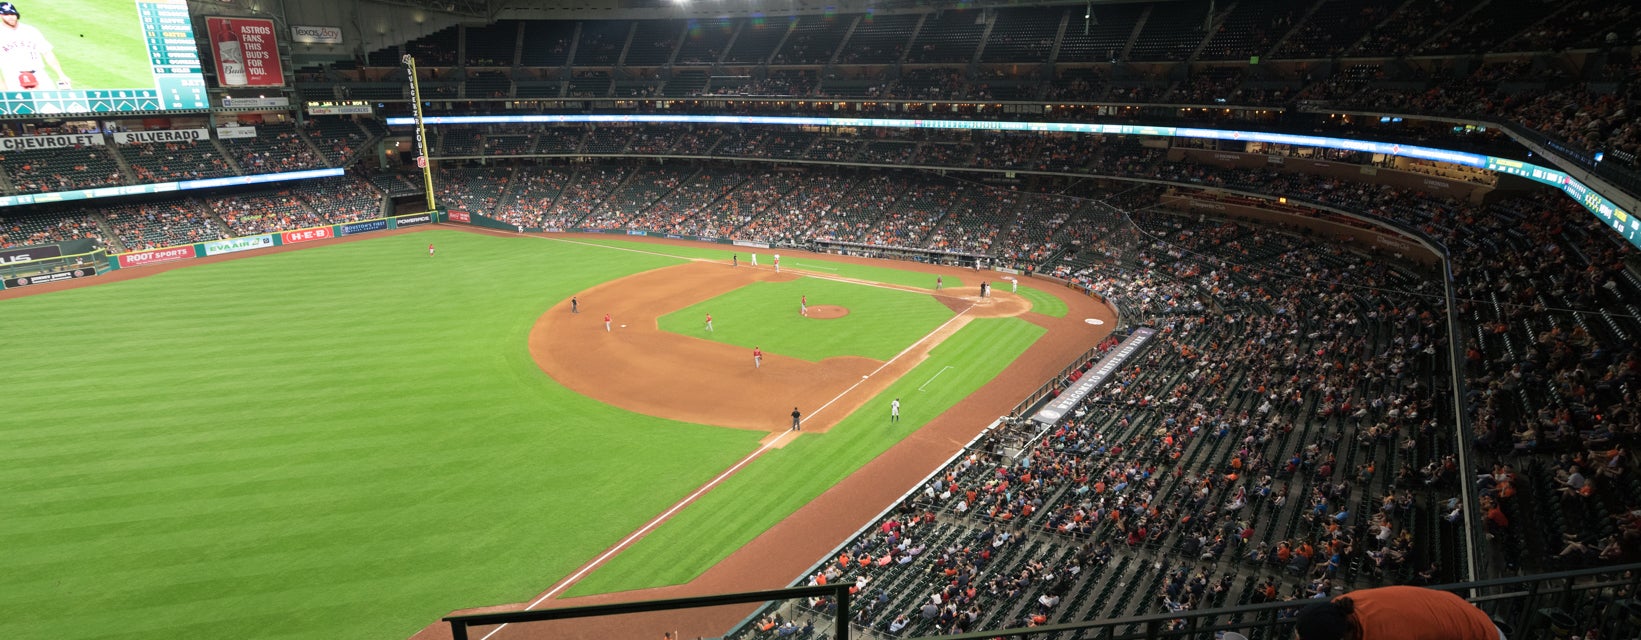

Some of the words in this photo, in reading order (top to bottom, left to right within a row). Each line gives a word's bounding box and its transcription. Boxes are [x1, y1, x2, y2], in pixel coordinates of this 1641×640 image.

[241, 25, 271, 35] ASTROS
[242, 34, 265, 43] FANS,
[244, 43, 262, 51] THIS
[246, 51, 270, 59] BUD'S
[247, 59, 263, 67] FOR
[249, 67, 268, 75] YOU.
[126, 130, 199, 143] SILVERADO
[3, 135, 93, 150] CHEVROLET
[209, 243, 231, 252] EVA
[232, 241, 250, 250] AIR
[127, 252, 155, 263] ROOT
[155, 248, 187, 259] SPORTS
[1057, 382, 1093, 410] WELCOME
[1088, 375, 1101, 384] TO
[1097, 354, 1121, 375] MINUTE
[1116, 346, 1134, 359] MAID
[1133, 335, 1146, 348] PARK
